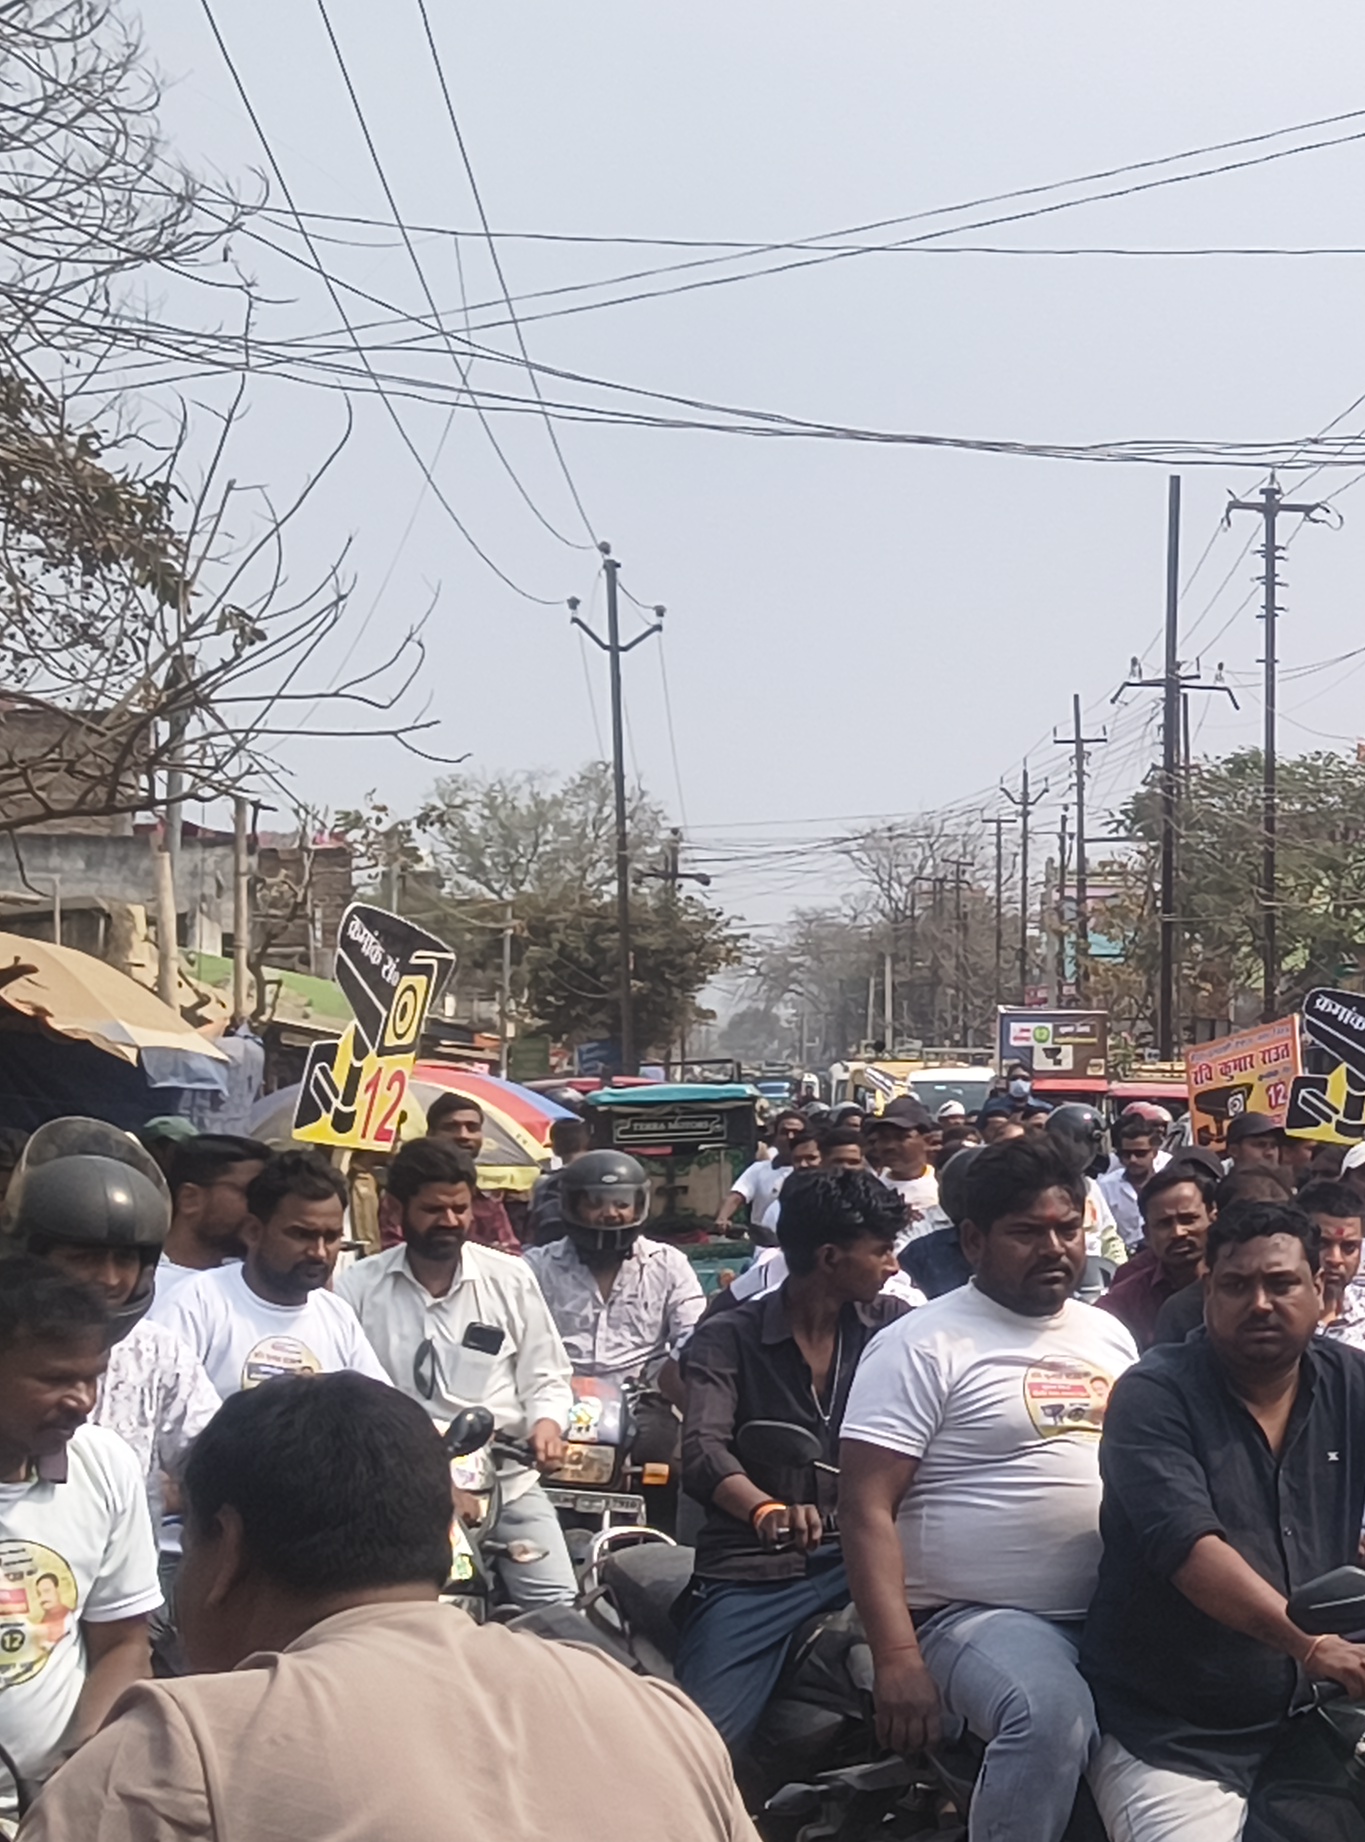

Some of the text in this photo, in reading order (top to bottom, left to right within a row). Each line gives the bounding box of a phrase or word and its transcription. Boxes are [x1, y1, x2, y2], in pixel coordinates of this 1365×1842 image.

[347, 914, 385, 966] क्रमांक
[1191, 1063, 1214, 1086] रवि
[1217, 1053, 1255, 1082] कुमार
[361, 1066, 407, 1143] 12
[1268, 1083, 1288, 1108] 12
